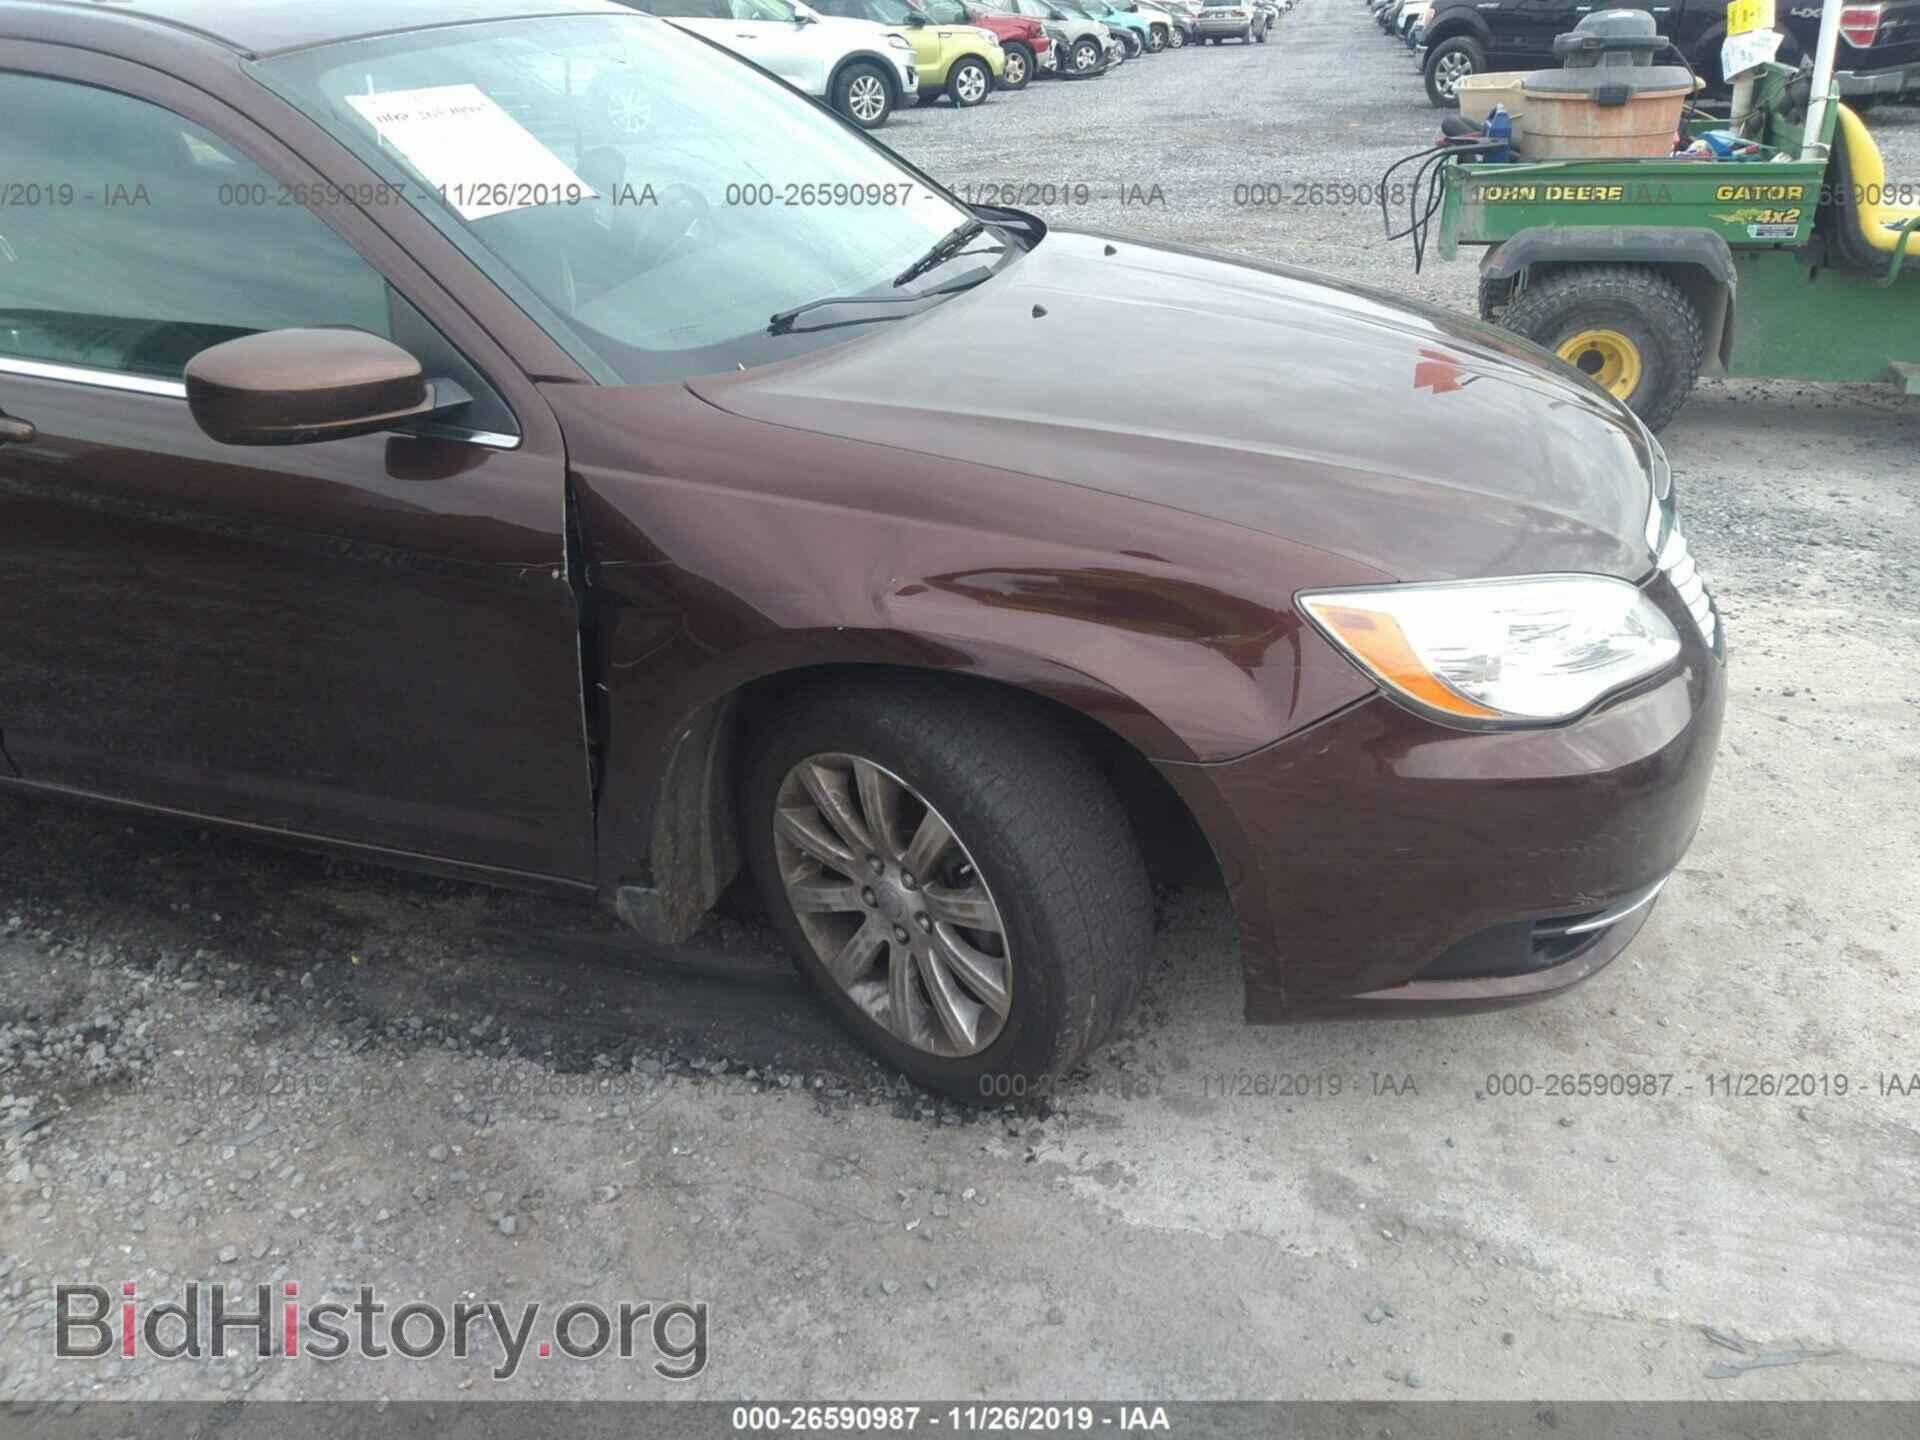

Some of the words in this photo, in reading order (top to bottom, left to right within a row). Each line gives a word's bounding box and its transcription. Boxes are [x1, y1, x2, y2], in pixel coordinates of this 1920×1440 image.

[1472, 185, 1536, 201] JOHN
[1545, 185, 1624, 201] DEERE
[1716, 185, 1804, 201] GATOR
[1756, 208, 1800, 224] 4x2
